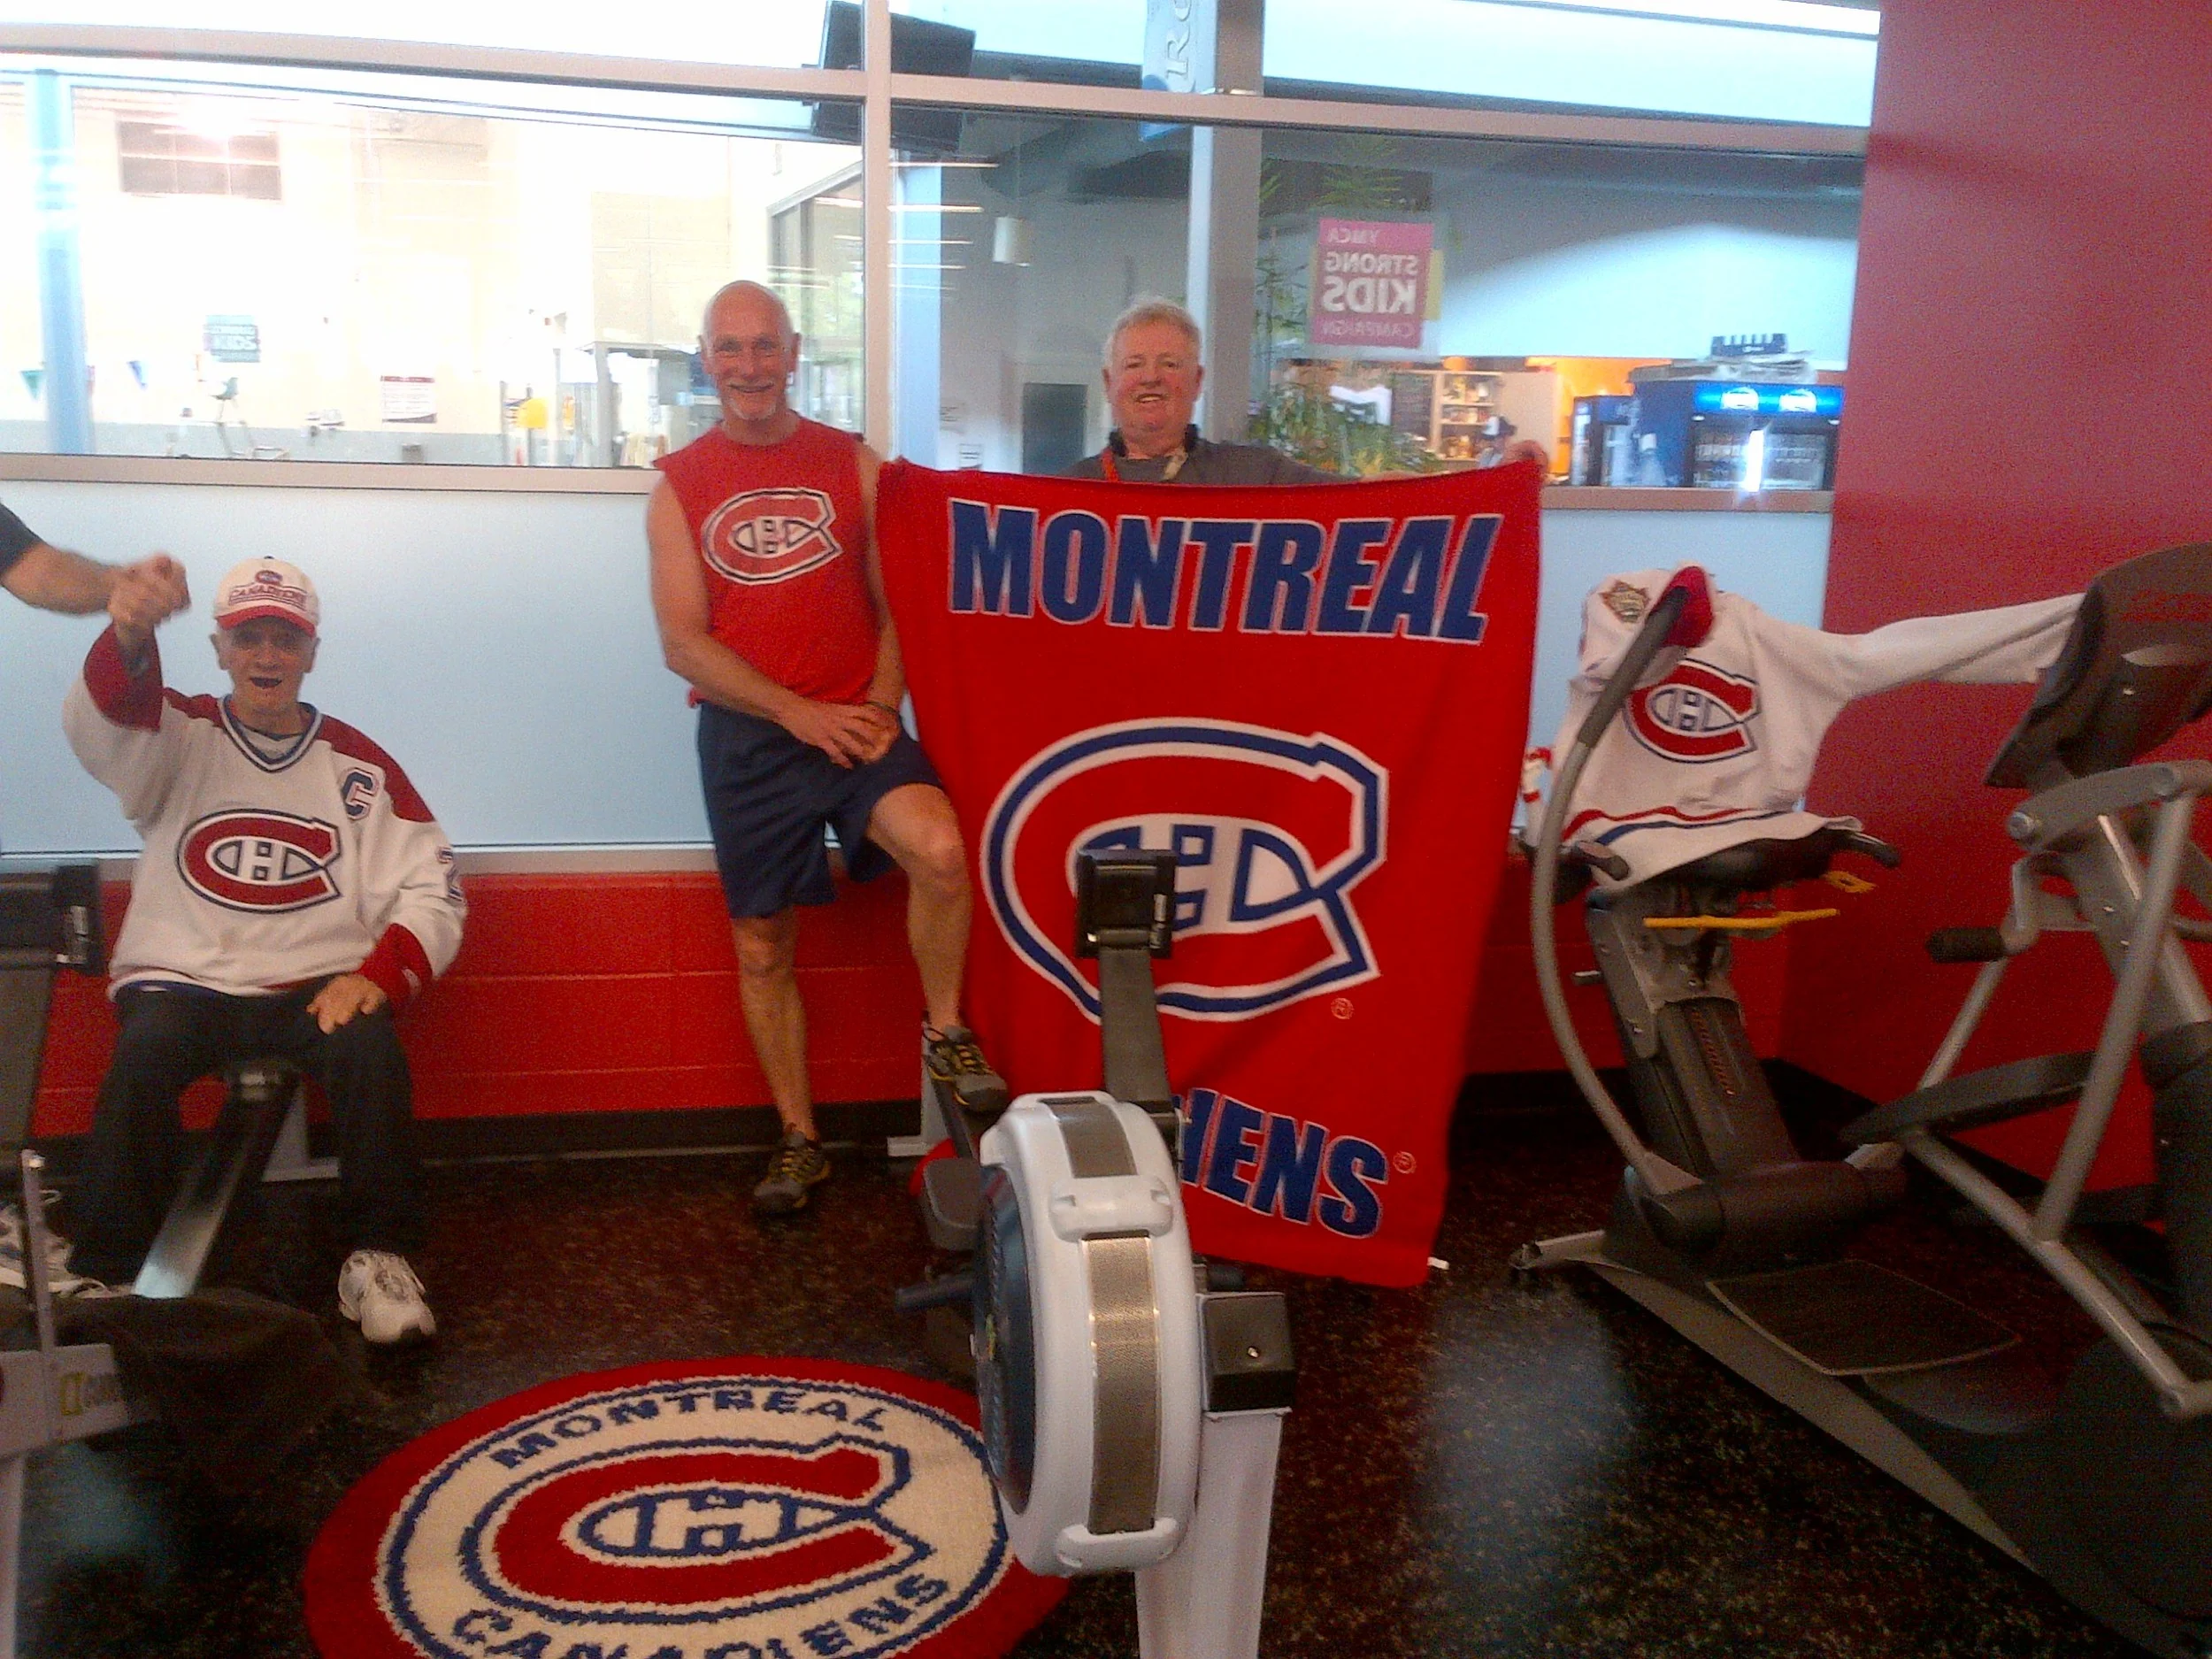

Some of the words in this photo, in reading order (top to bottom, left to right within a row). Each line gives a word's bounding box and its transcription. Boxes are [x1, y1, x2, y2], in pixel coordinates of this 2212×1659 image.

[948, 497, 1504, 645] MONTREAL
[1172, 1087, 1389, 1239] IENS
[489, 1389, 887, 1469] MONTREAL
